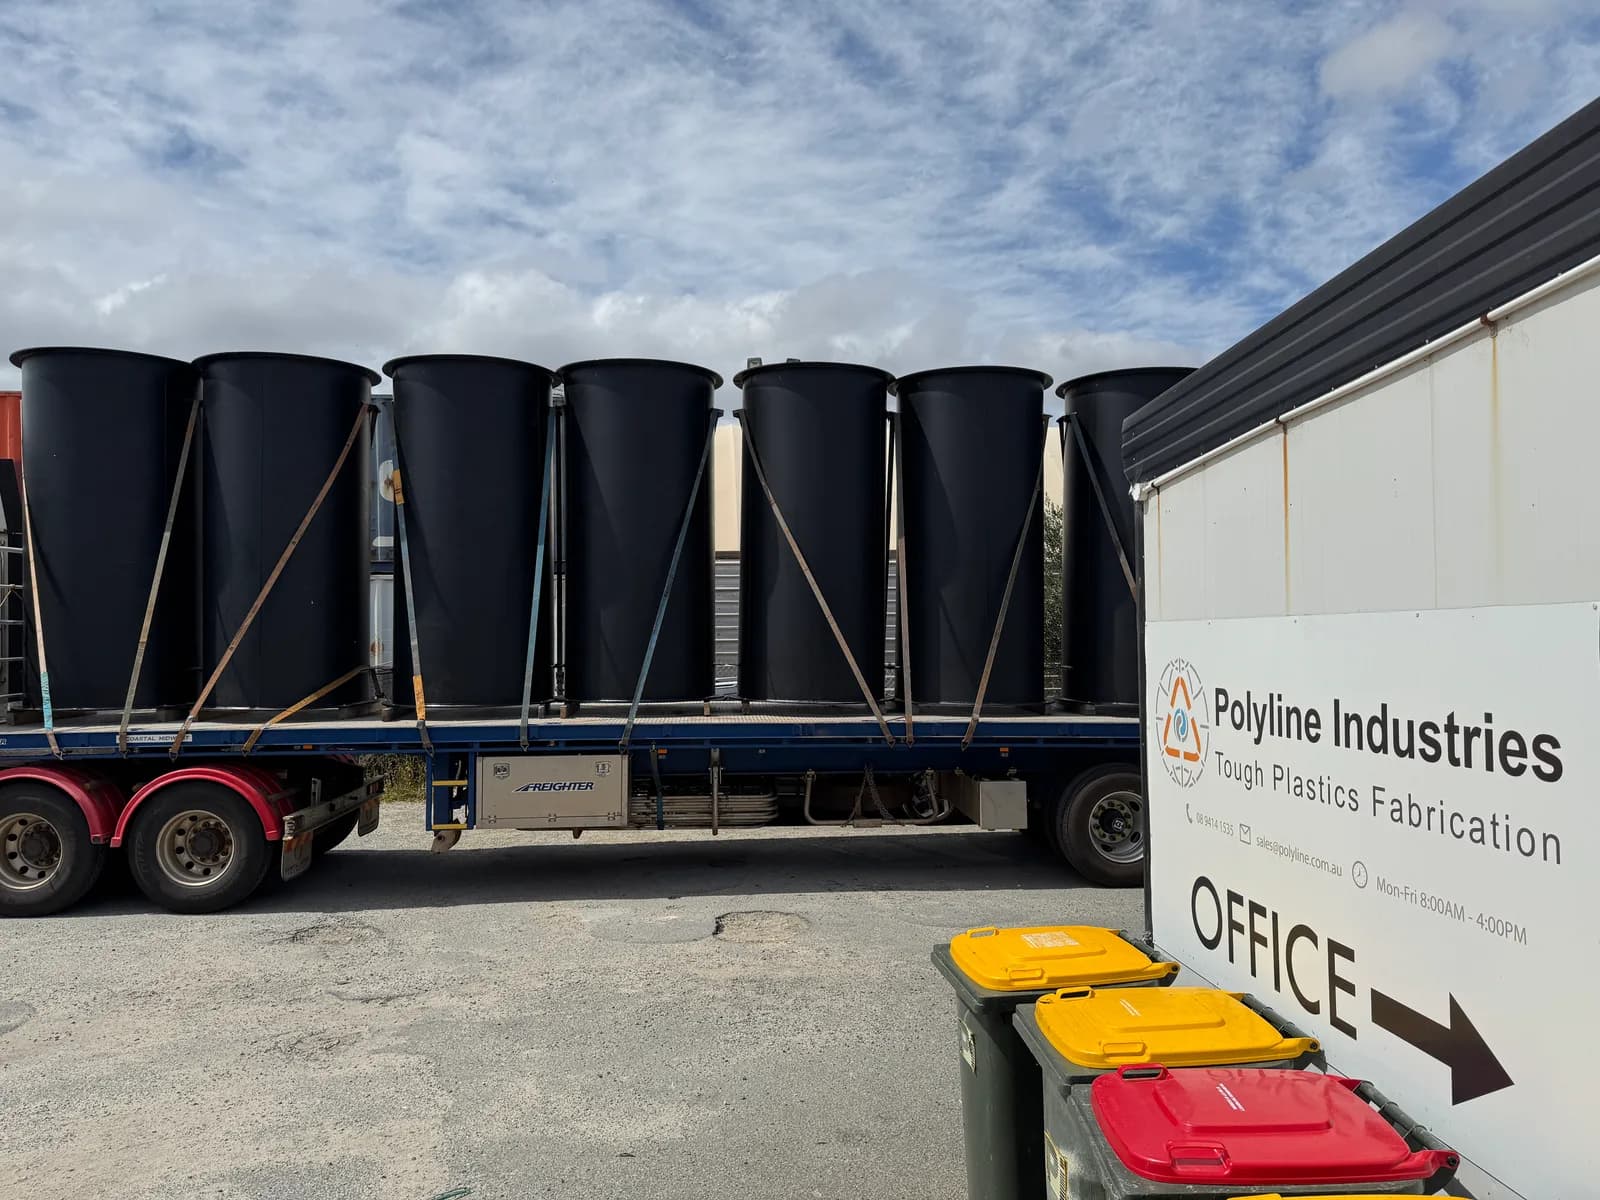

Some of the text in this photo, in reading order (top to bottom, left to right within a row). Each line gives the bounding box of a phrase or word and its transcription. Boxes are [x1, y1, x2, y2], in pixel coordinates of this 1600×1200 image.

[1215, 687, 1563, 783] Polyline Industries
[519, 781, 594, 792] FREIGHTER
[1215, 751, 1561, 865] Tough Plastics Fabrication
[1196, 812, 1234, 836] 08 9414 1535
[1256, 835, 1343, 877] sales@polyline.com.au
[1376, 876, 1417, 904] Mon-Fri
[1420, 892, 1465, 922] 8:00AM
[1476, 912, 1527, 945] 4:00PM
[1191, 876, 1357, 1040] OFFICE
